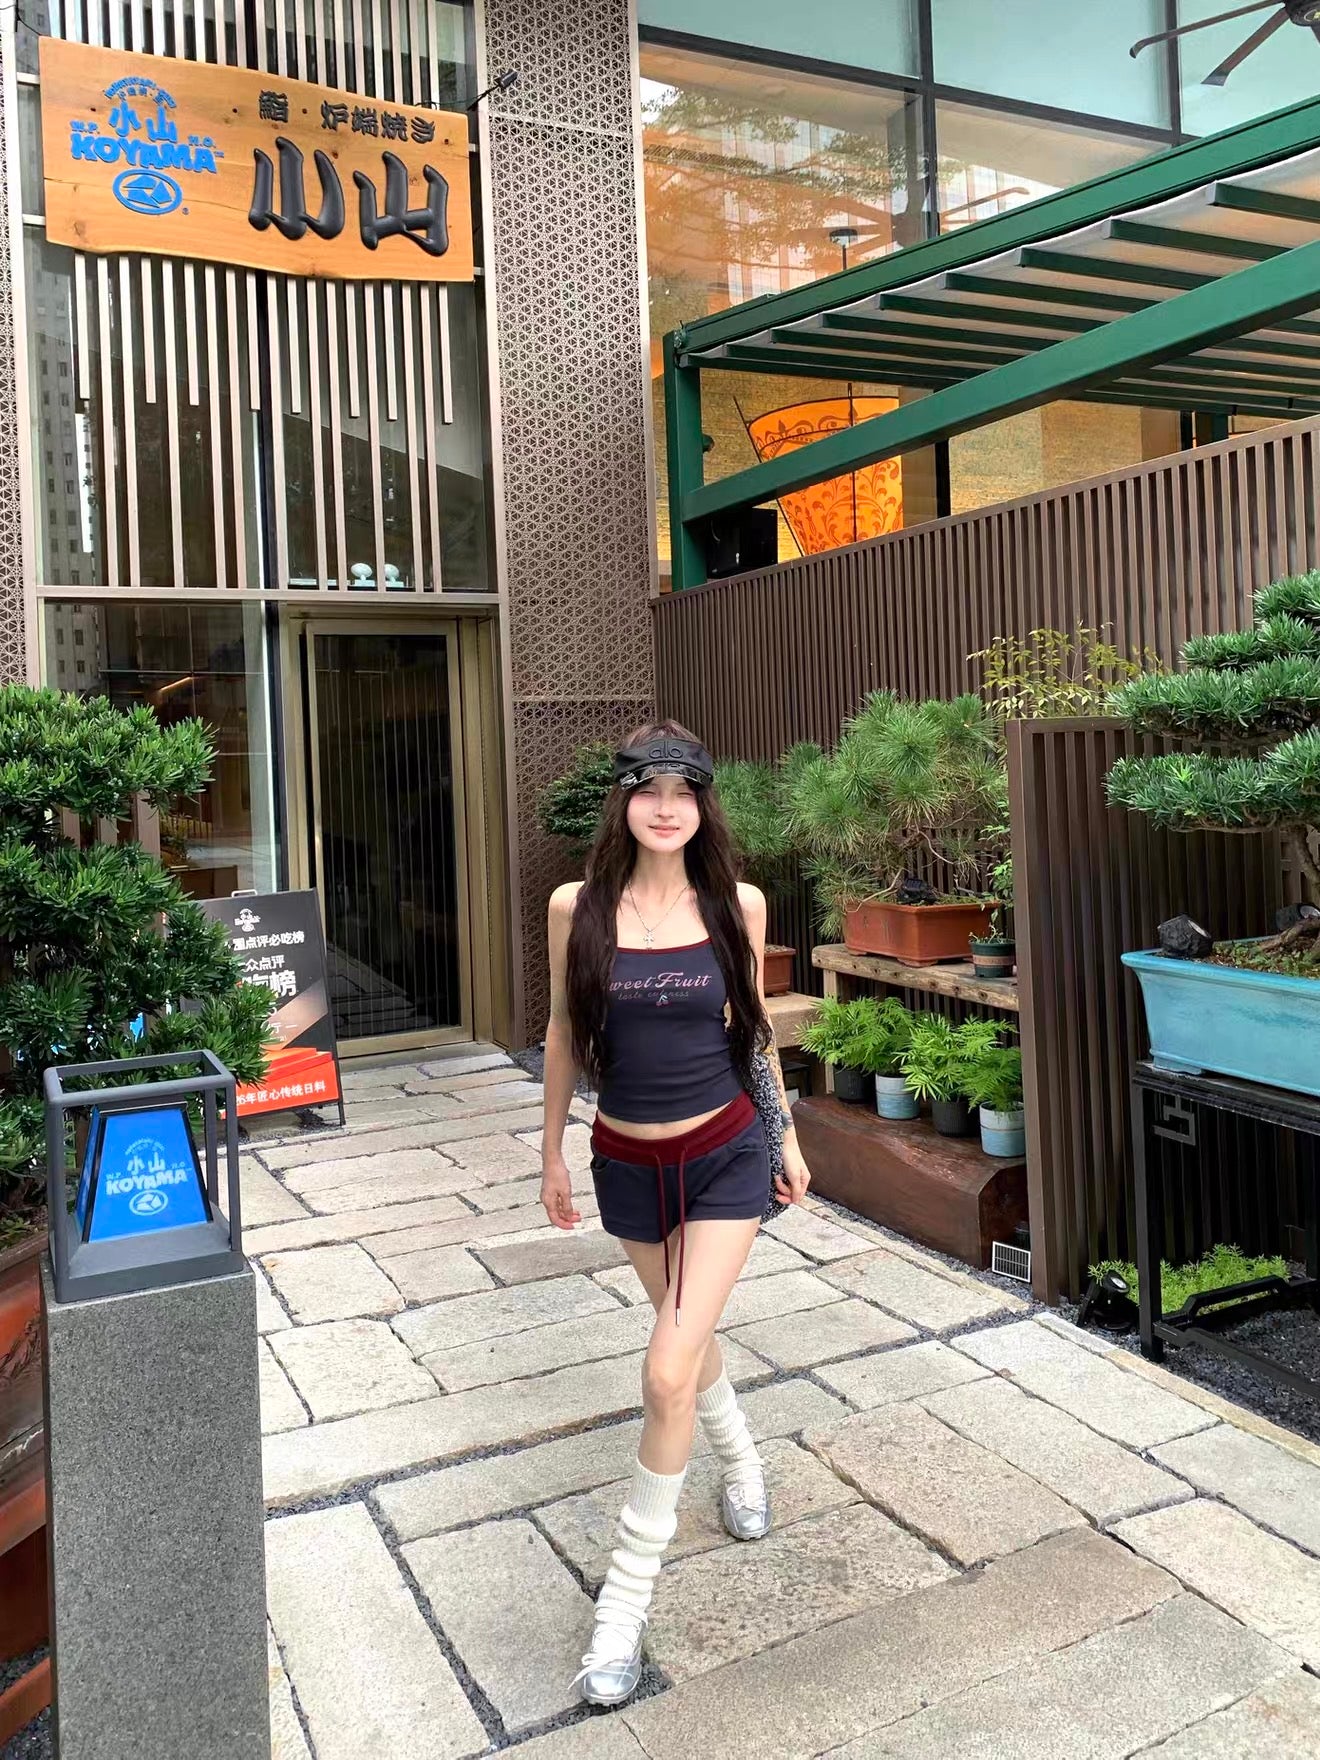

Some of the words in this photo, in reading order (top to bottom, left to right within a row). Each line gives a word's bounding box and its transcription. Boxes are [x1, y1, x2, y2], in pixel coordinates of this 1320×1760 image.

[108, 99, 178, 143] 小山
[70, 132, 217, 174] KOYAMA
[248, 135, 449, 257] 小山
[608, 975, 655, 992] weet
[654, 971, 712, 989] Fruit
[105, 1168, 188, 1196] KOYAMA
